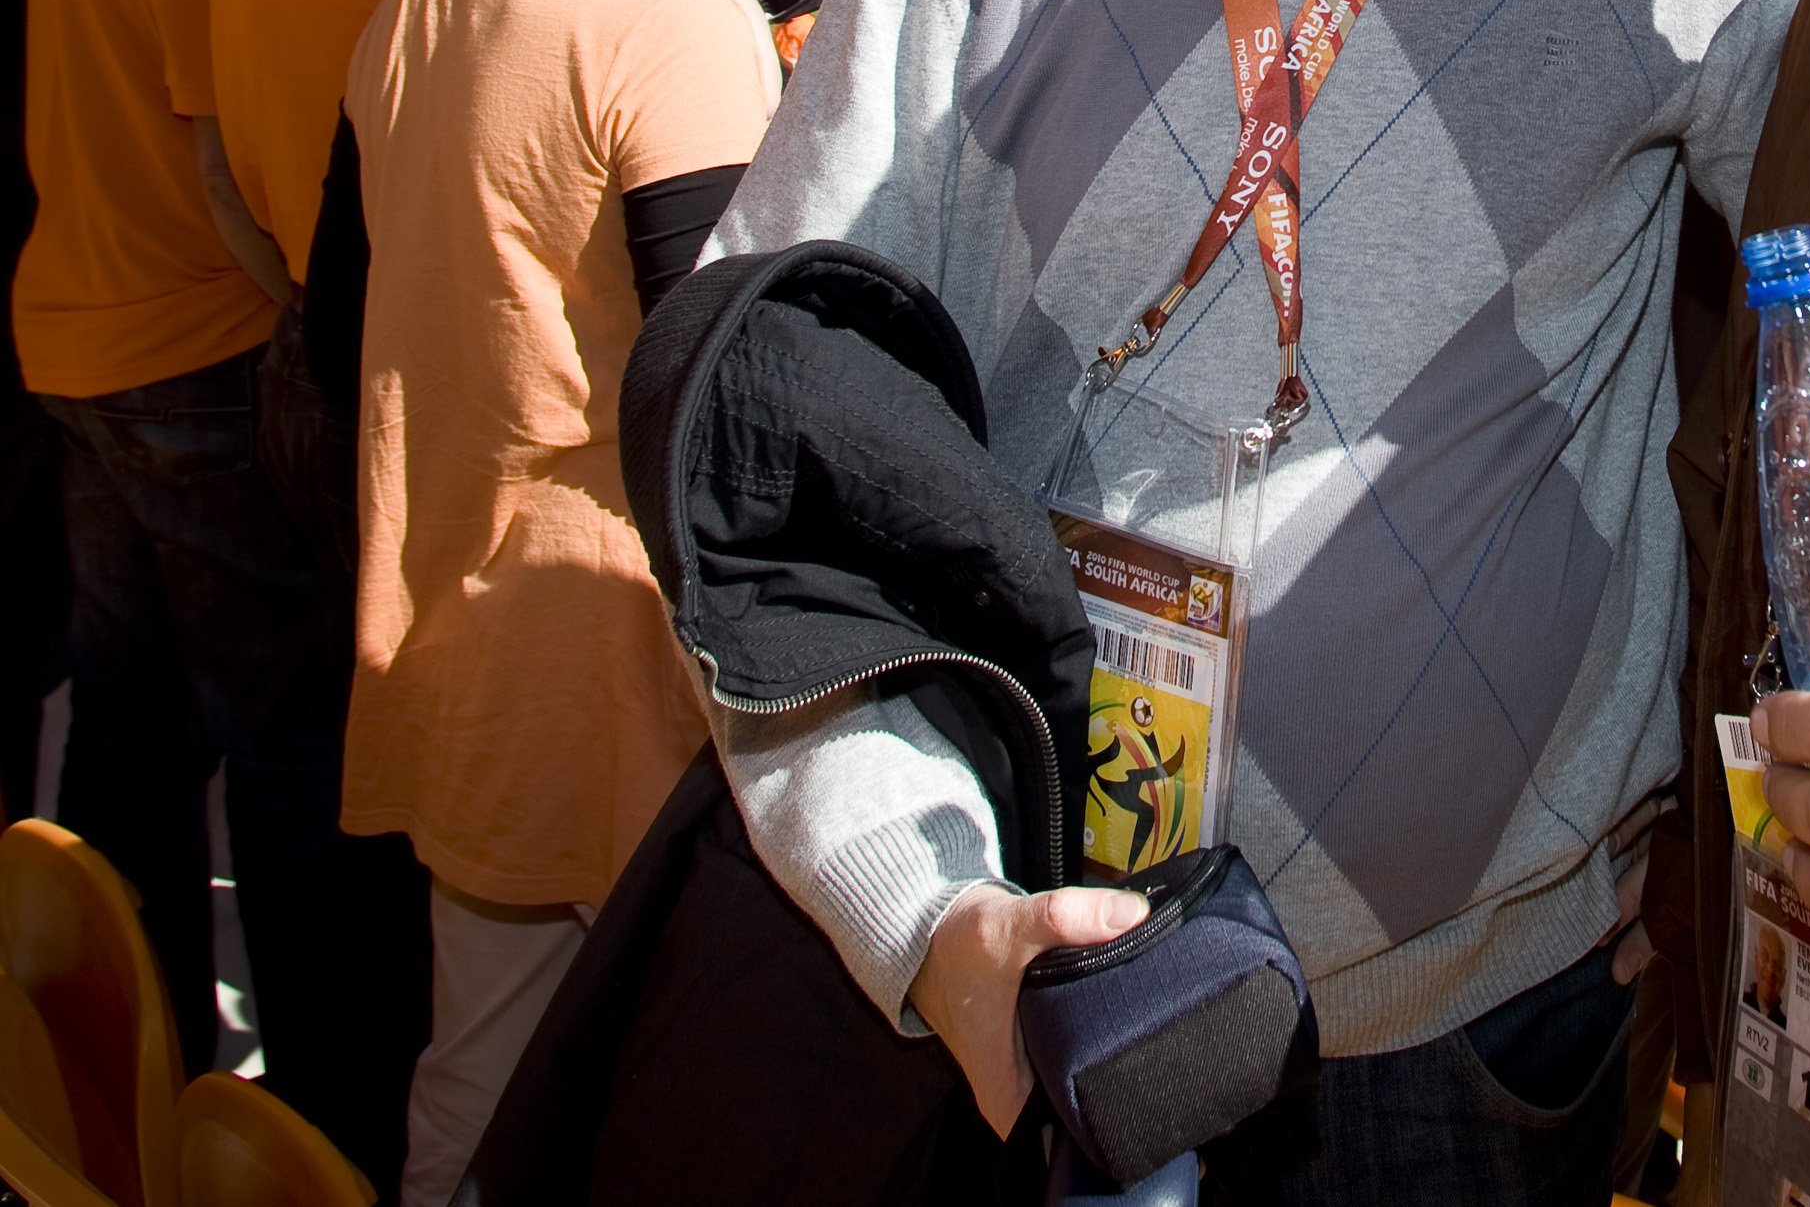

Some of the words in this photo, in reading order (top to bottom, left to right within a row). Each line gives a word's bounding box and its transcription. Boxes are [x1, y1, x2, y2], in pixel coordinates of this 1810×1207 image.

[1317, 0, 1350, 51] WORLD
[1302, 52, 1323, 81] CUP
[1217, 121, 1287, 237] SONY
[1085, 562, 1128, 588] SOUTH
[1130, 577, 1178, 605] AFRICA
[1086, 550, 1107, 564] 2010
[1107, 557, 1126, 571] FIFA
[1128, 564, 1160, 582] WORLD
[1161, 575, 1180, 588] CUP
[1745, 867, 1777, 902] FIFA
[1746, 1025, 1769, 1052] RTV2
